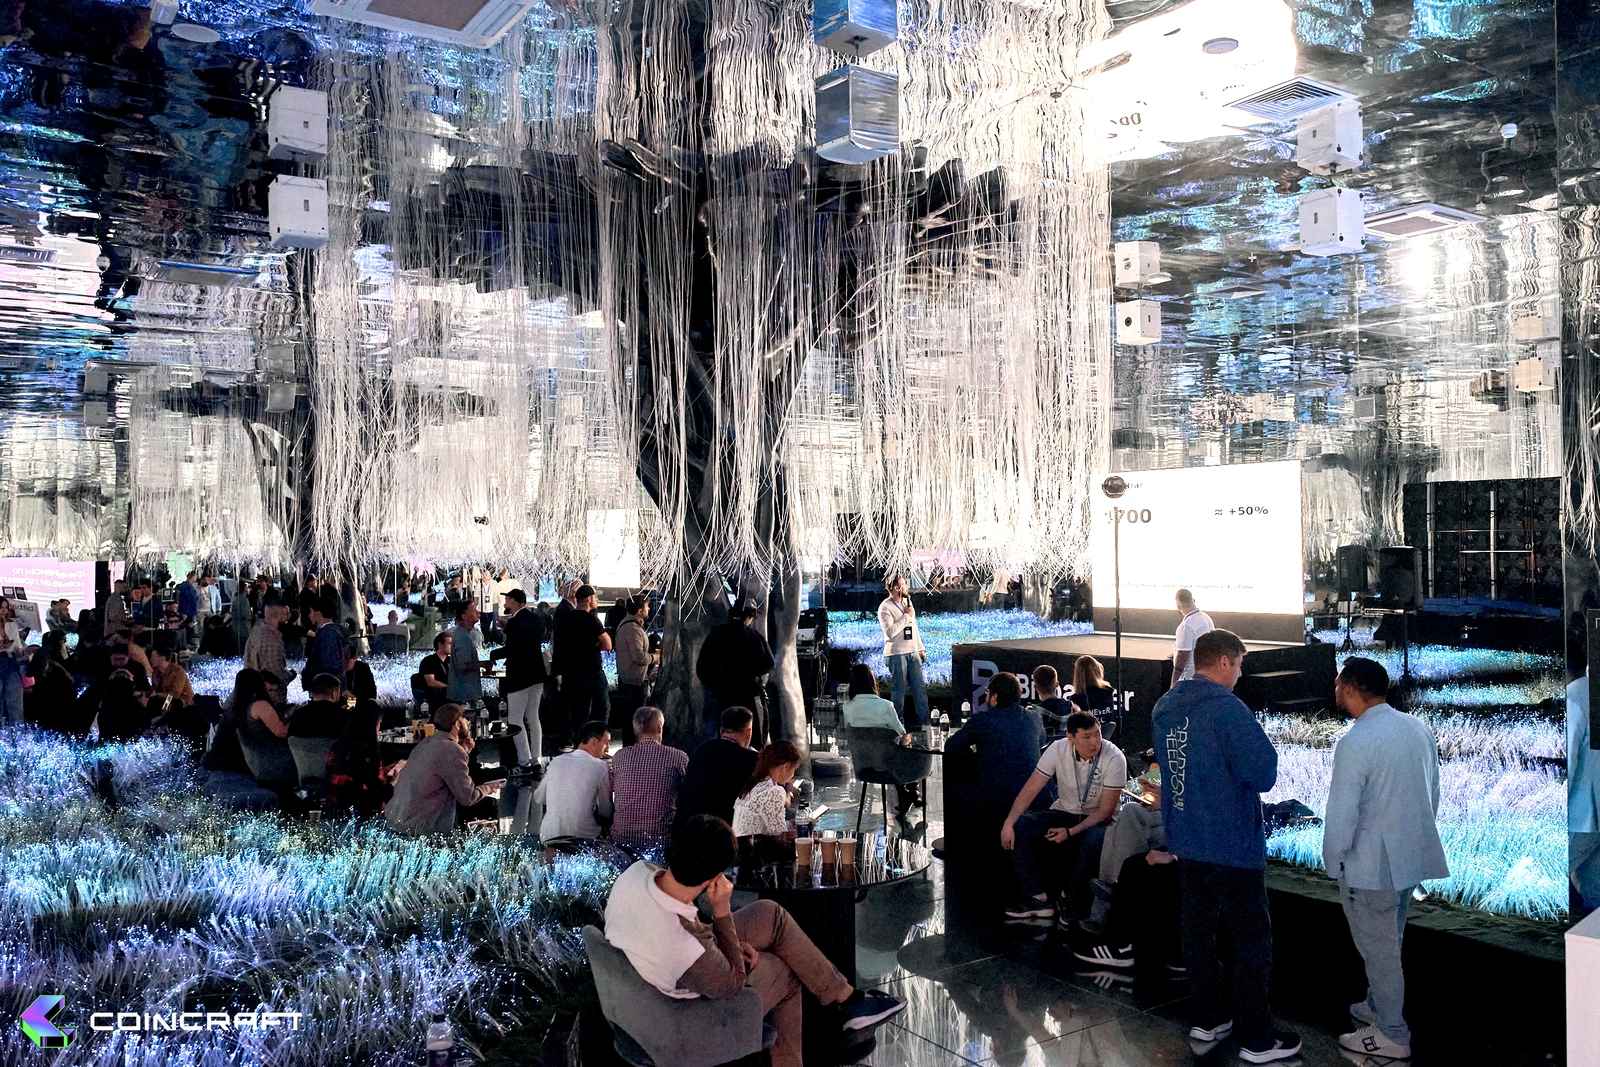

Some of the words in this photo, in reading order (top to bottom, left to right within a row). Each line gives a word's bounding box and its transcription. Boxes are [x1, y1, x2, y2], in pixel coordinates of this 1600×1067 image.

[1104, 508, 1152, 524] 700
[1229, 506, 1269, 516] +50%
[1016, 673, 1134, 711] Biaer
